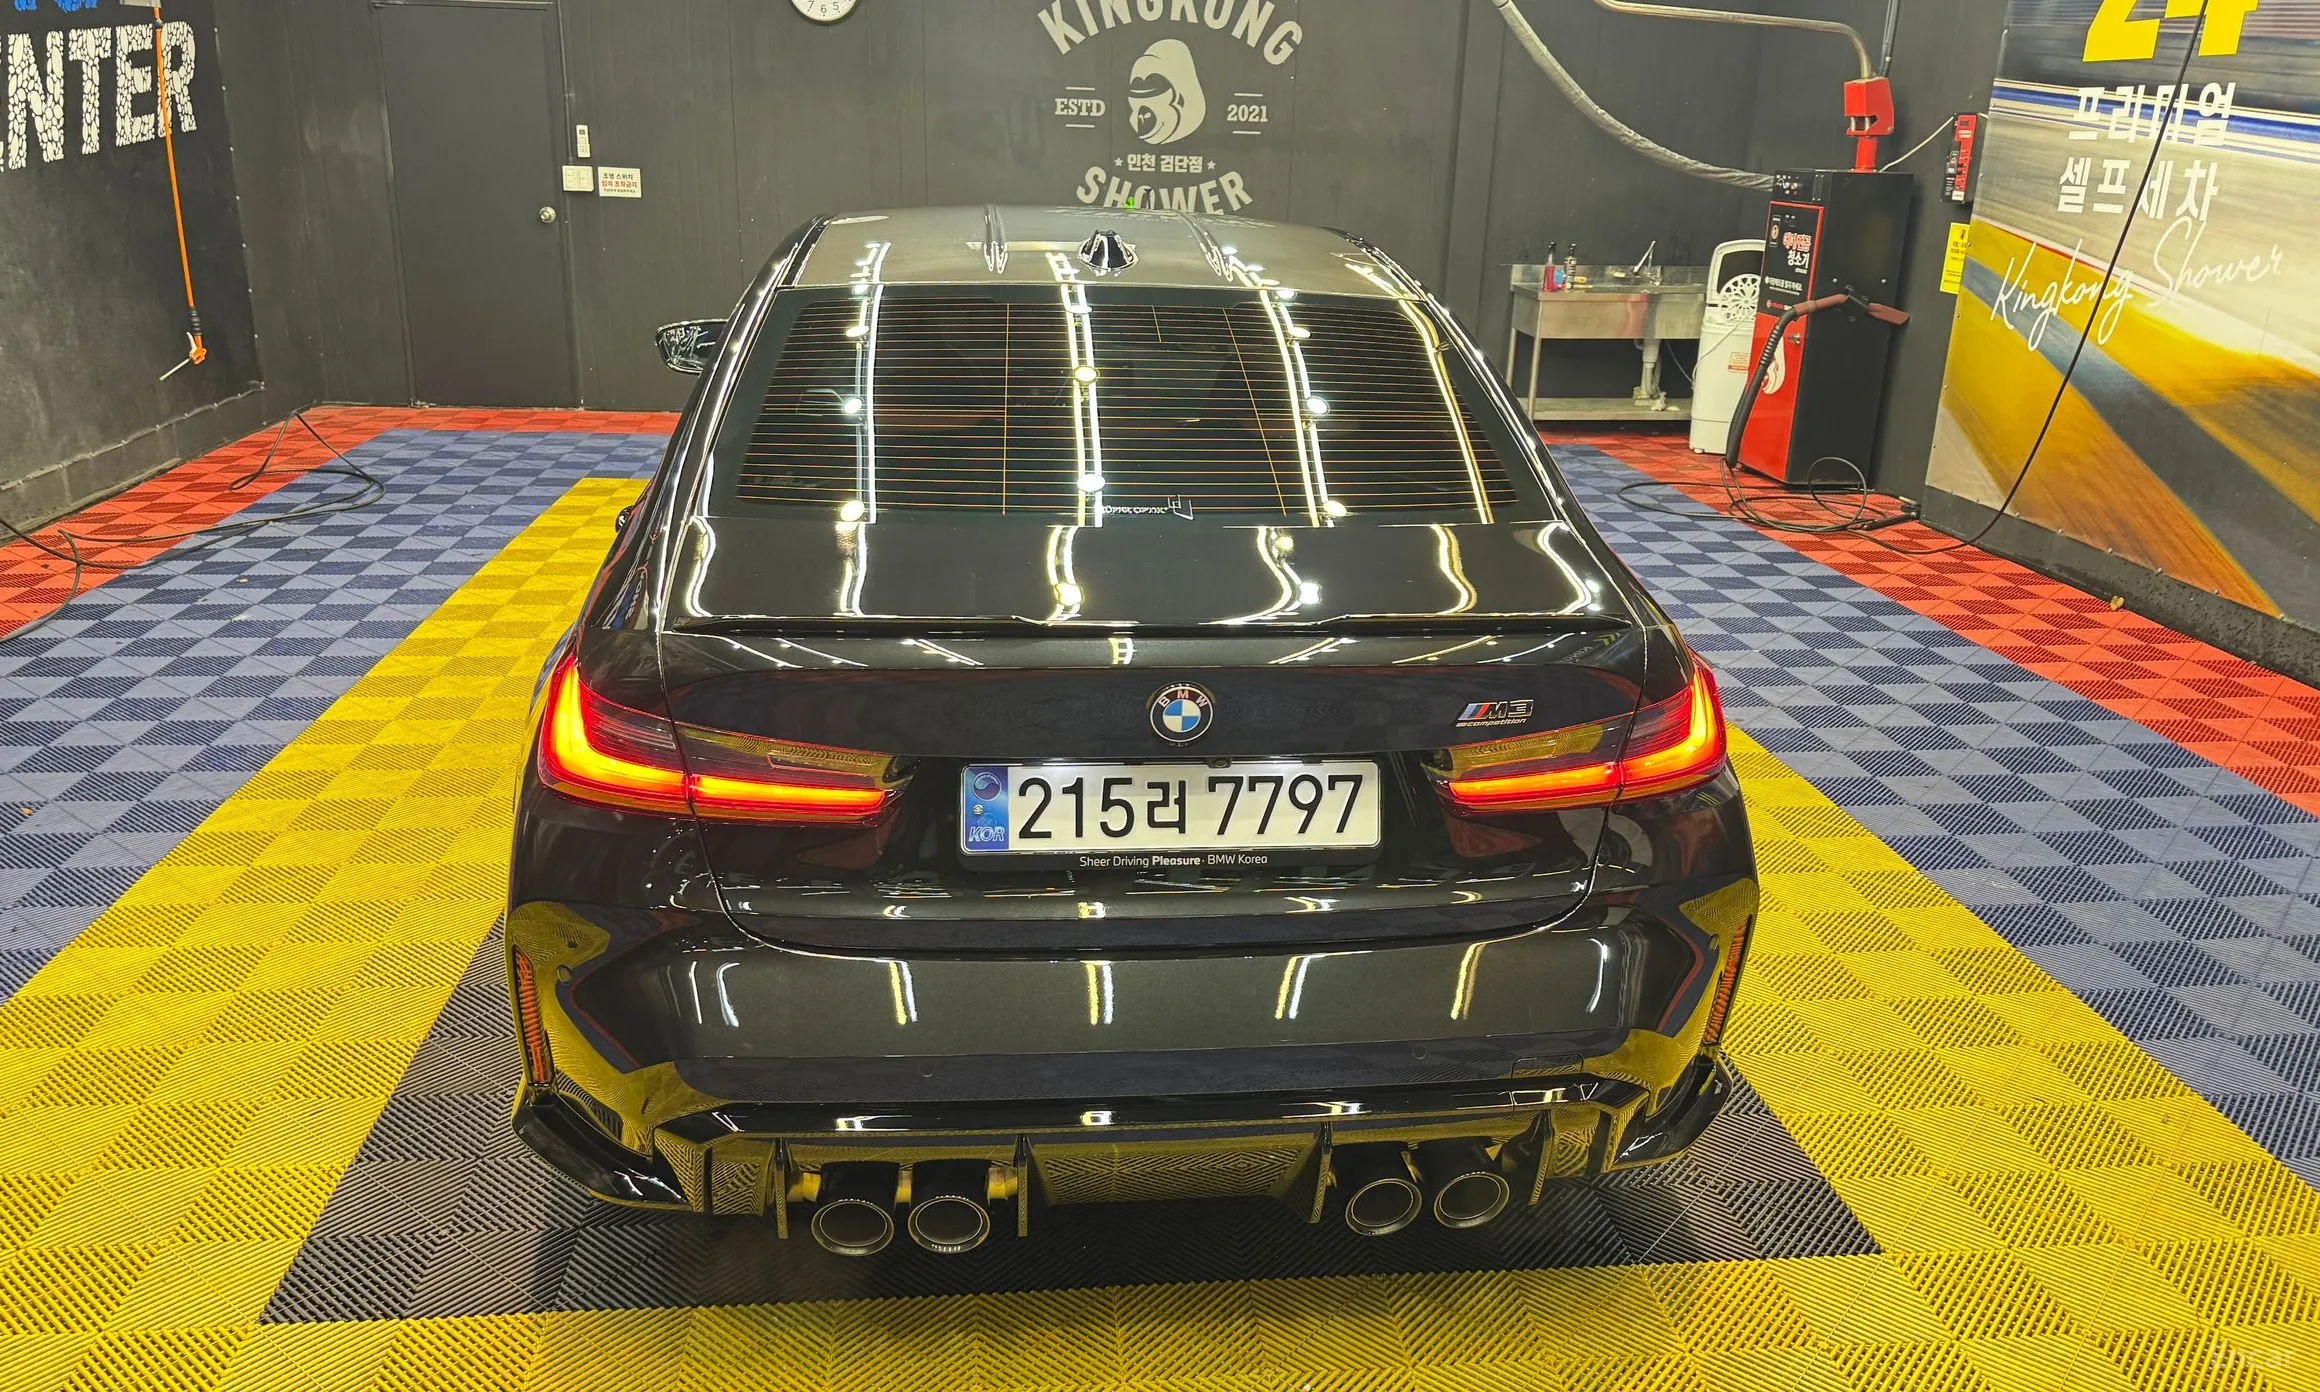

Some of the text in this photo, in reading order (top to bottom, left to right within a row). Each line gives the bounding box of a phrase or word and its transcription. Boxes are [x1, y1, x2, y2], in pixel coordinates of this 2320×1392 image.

[821, 5, 827, 14] 6
[832, 2, 839, 10] 5
[0, 21, 197, 172] NTER
[1054, 98, 1106, 117] ESTD
[1227, 104, 1268, 122] 2021
[2068, 82, 2236, 146] 프리미엄
[1127, 153, 1203, 173] 인천 검단점
[1076, 166, 1253, 217] SHOWER
[1787, 250, 1810, 269] 청소기
[1990, 216, 2283, 351] Kingkong Shower
[1158, 690, 1208, 708] BMW
[1467, 718, 1527, 728] competition
[1207, 774, 1364, 836] 7797
[968, 826, 1006, 842] KOR
[1079, 856, 1111, 867] Sheer
[1113, 855, 1150, 868] Driving
[1208, 854, 1236, 865] BMW
[1238, 854, 1268, 864] Korea
